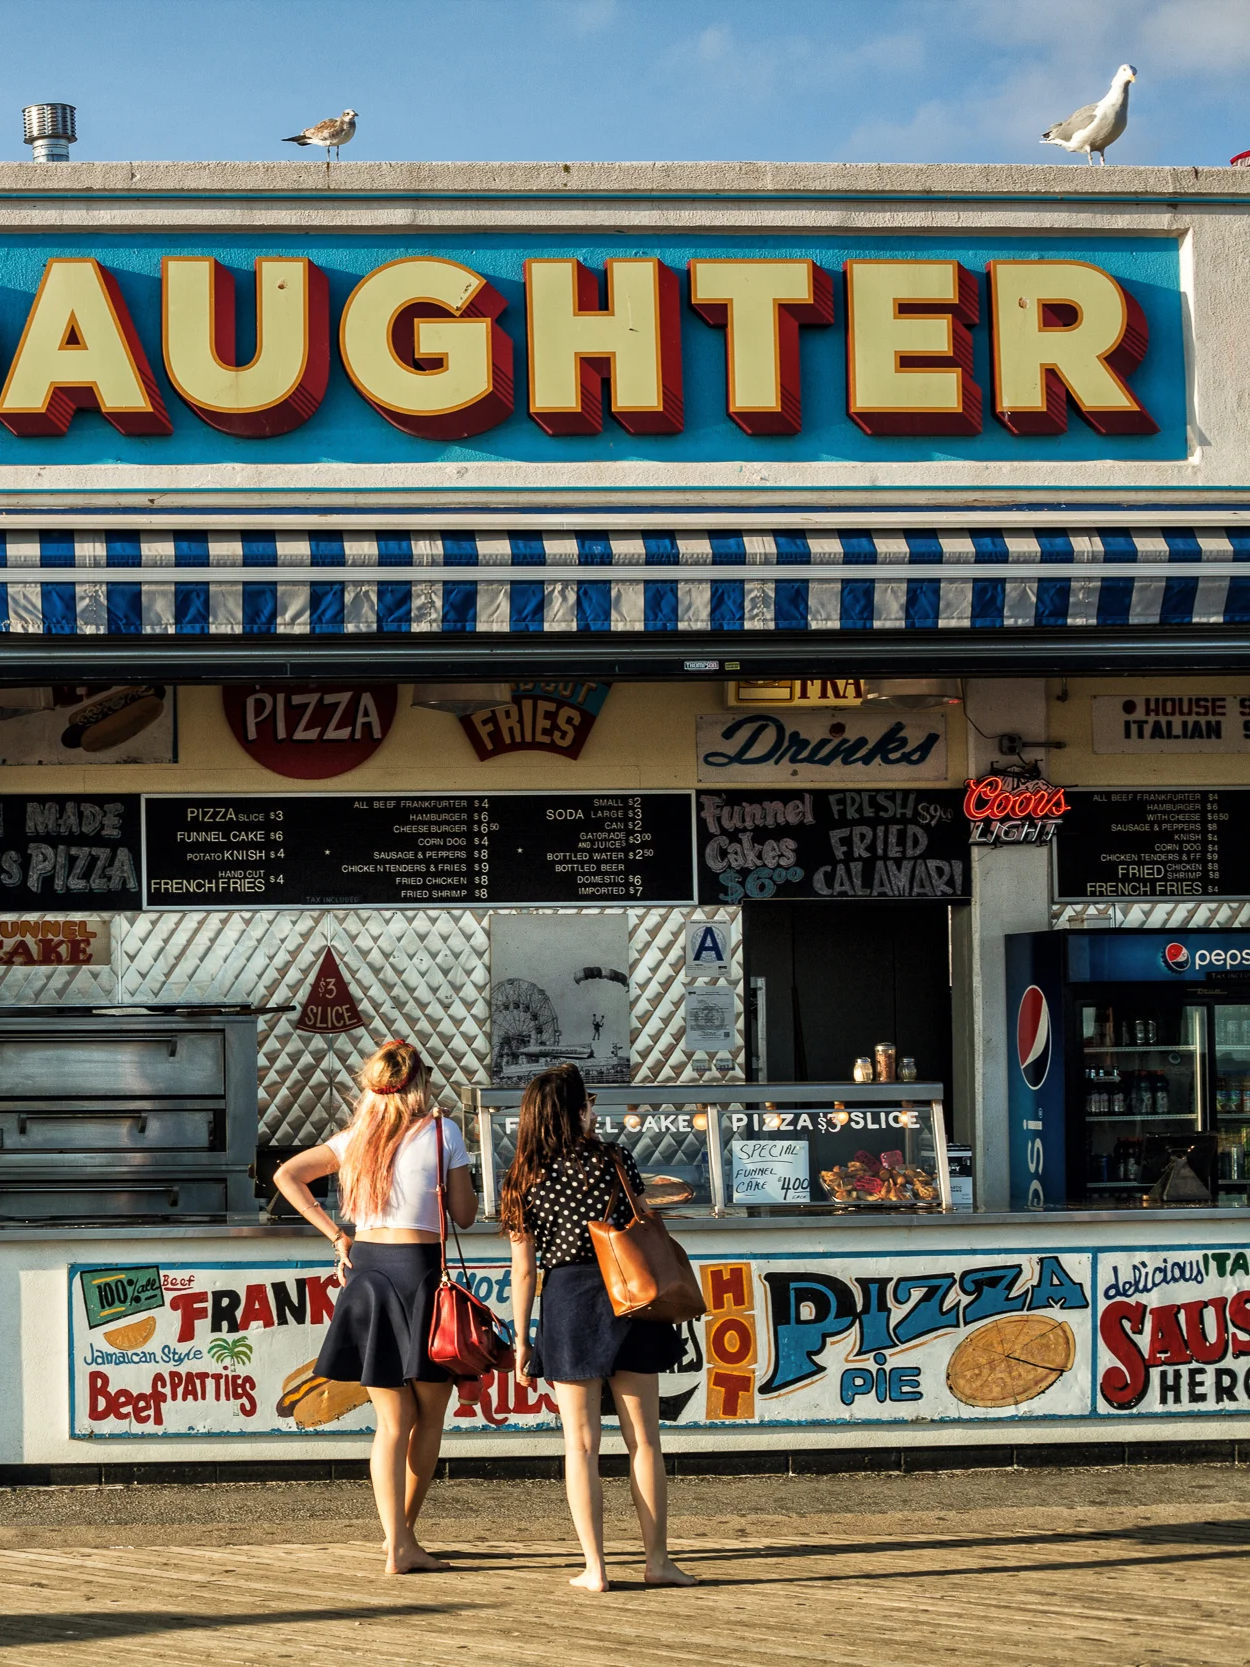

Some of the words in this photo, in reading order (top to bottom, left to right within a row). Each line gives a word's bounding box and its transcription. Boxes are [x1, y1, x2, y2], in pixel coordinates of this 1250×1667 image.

[245, 690, 384, 743] PIZZA
[1145, 697, 1226, 717] HOUSE
[471, 698, 582, 751] FRIES
[1124, 719, 1222, 740] ITALIAN
[703, 714, 941, 768] Drinks
[828, 791, 918, 820] FRESH
[963, 775, 1072, 820] Coors
[1146, 803, 1201, 812] HAMBURGER
[1206, 802, 1218, 811] $6
[25, 800, 126, 839] MADE
[187, 807, 236, 822] PIZZA
[237, 813, 264, 822] SLICE
[269, 810, 283, 821] $3
[409, 812, 467, 822] HAMBURGER
[473, 811, 488, 823] $6
[546, 809, 584, 821] SODA
[699, 792, 817, 836] Funnel
[177, 831, 227, 843] FUNNEL
[229, 830, 264, 842] CAKE
[269, 830, 283, 842] $6
[417, 837, 443, 846] CORN
[446, 837, 466, 846] DOG
[473, 836, 488, 847] $4
[828, 824, 929, 860] FRIED
[968, 818, 1064, 844] LIGHT
[1173, 832, 1201, 841] KNISH
[1207, 833, 1217, 841] $4
[186, 852, 222, 862] POTATO
[224, 849, 265, 861] KNISH
[269, 848, 284, 859] $4
[704, 831, 799, 874] Cakes
[26, 842, 140, 894] PIZZA
[218, 870, 244, 878] HAND
[245, 869, 264, 878] CUT
[576, 875, 624, 884] DOMESTIC
[628, 874, 641, 886] $6
[812, 859, 964, 898] CALAMARI
[151, 879, 215, 893] FRENCH
[218, 878, 265, 893] FRIES
[269, 874, 284, 885] $4
[1087, 882, 1151, 896] FRENCH
[1155, 882, 1203, 896] FRIES
[1207, 885, 1218, 893] $4
[693, 927, 725, 961] A
[319, 975, 337, 999] $3
[305, 1002, 358, 1028] SLICE
[624, 1114, 693, 1133] CAKE
[732, 1113, 814, 1132] PIZZA
[817, 1113, 842, 1134] $3
[850, 1111, 921, 1129] SLICE
[738, 1143, 799, 1161] SPECIAL
[734, 1166, 778, 1180] FUNNEL
[735, 1180, 768, 1194] CAKE
[163, 1274, 195, 1288] Beef
[1104, 1257, 1204, 1301] delicious
[97, 1278, 140, 1310] 100%
[758, 1255, 1091, 1396] PIZZA
[708, 1264, 754, 1420] HOT
[83, 1343, 157, 1366] Jamaican
[160, 1344, 204, 1367] Style
[88, 1371, 169, 1426] Beef
[1159, 1367, 1250, 1406] HER
